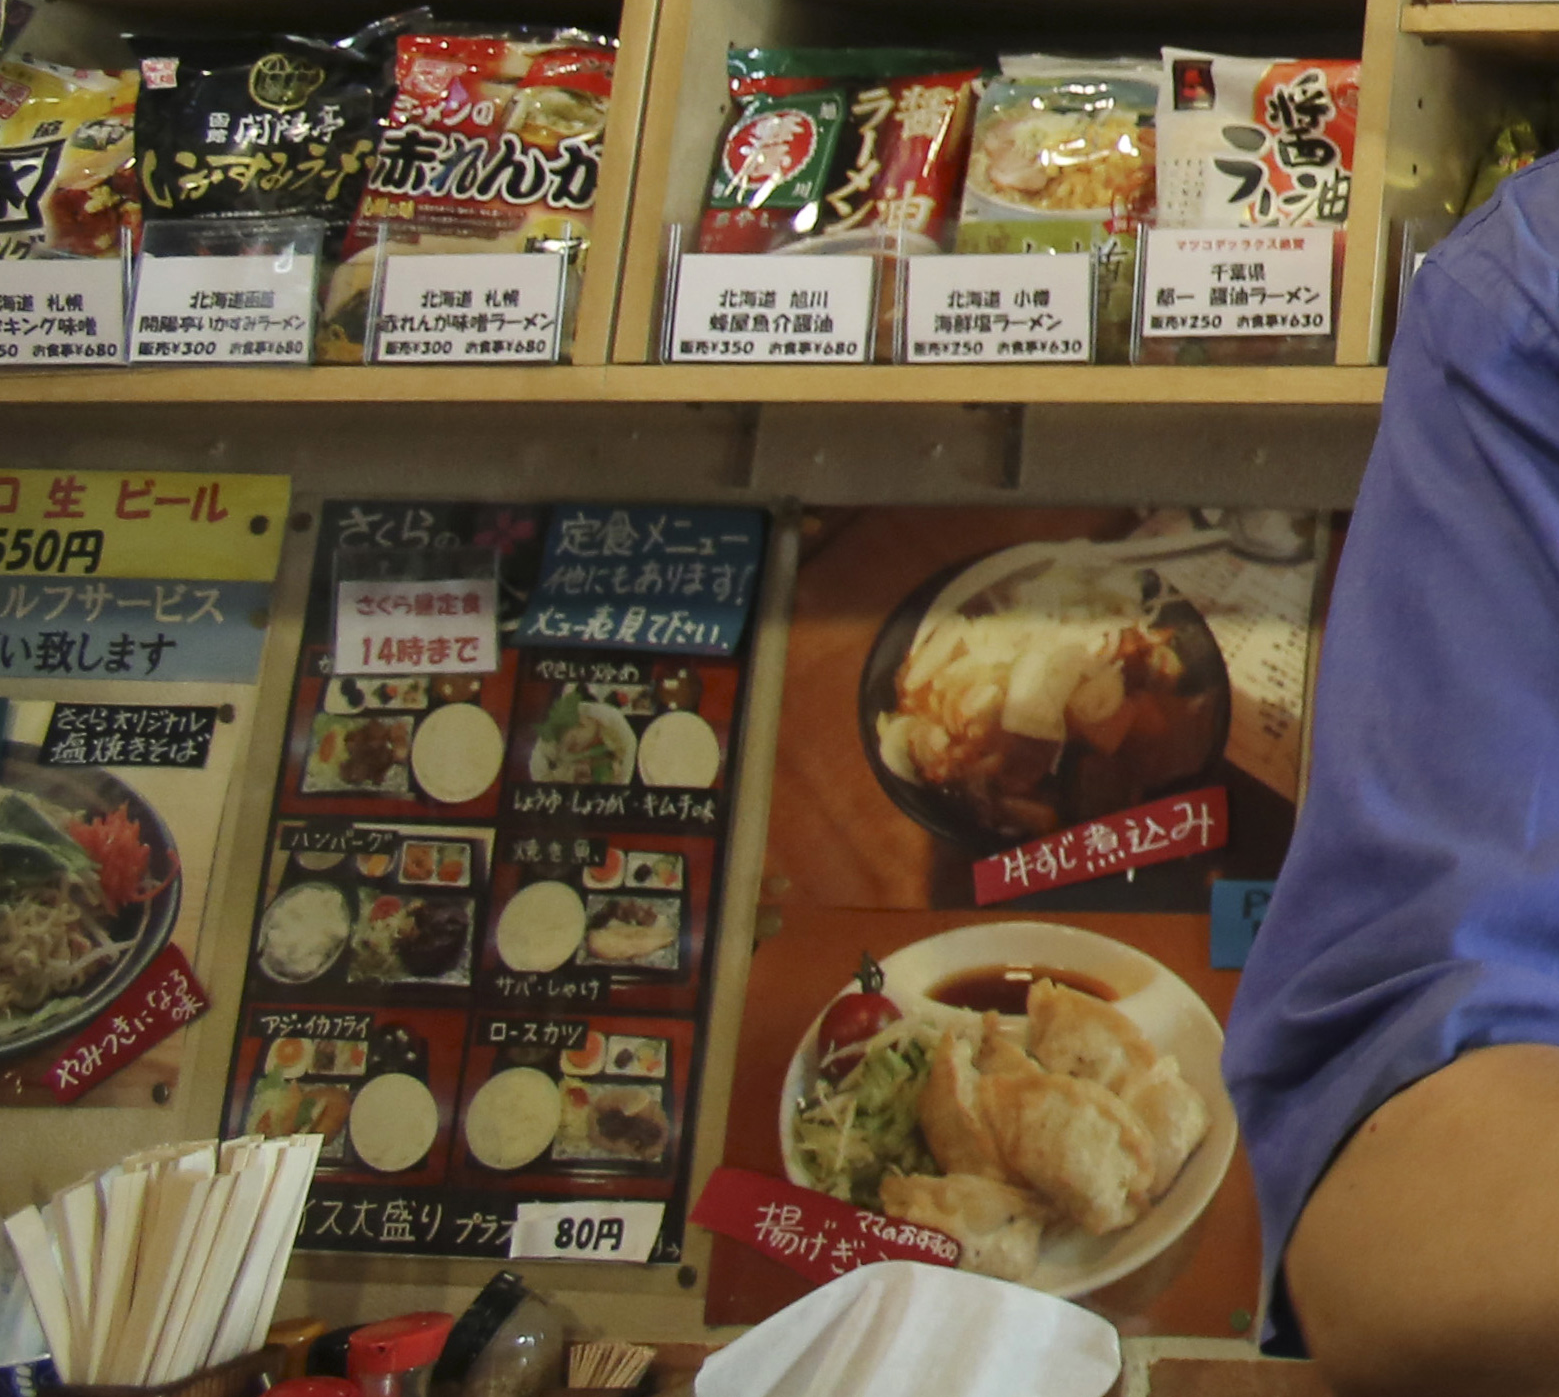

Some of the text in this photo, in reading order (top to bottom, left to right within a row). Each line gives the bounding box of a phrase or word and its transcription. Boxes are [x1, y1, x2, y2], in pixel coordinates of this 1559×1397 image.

[1210, 261, 1266, 283] 千葉県
[46, 293, 84, 312] 札幌
[420, 290, 520, 309] 北海道 札幌
[719, 288, 829, 309] 北海道 旭川
[947, 287, 1051, 308] 北海道 小樽
[1157, 284, 1320, 307] 都一 醤油ラーメン
[138, 316, 306, 334] 開陽亭いかすみラーメン
[709, 312, 834, 334] 蜂屋魚介醤油
[934, 311, 1062, 333] 海鮮塩ラーメン
[46, 476, 230, 523] 生 ビール
[555, 510, 750, 556] 定食メニュー
[361, 636, 480, 668] 14時まで
[291, 828, 392, 850] ハンバーグ
[489, 1021, 583, 1046] ロースカツ
[553, 1217, 625, 1253] 80円
